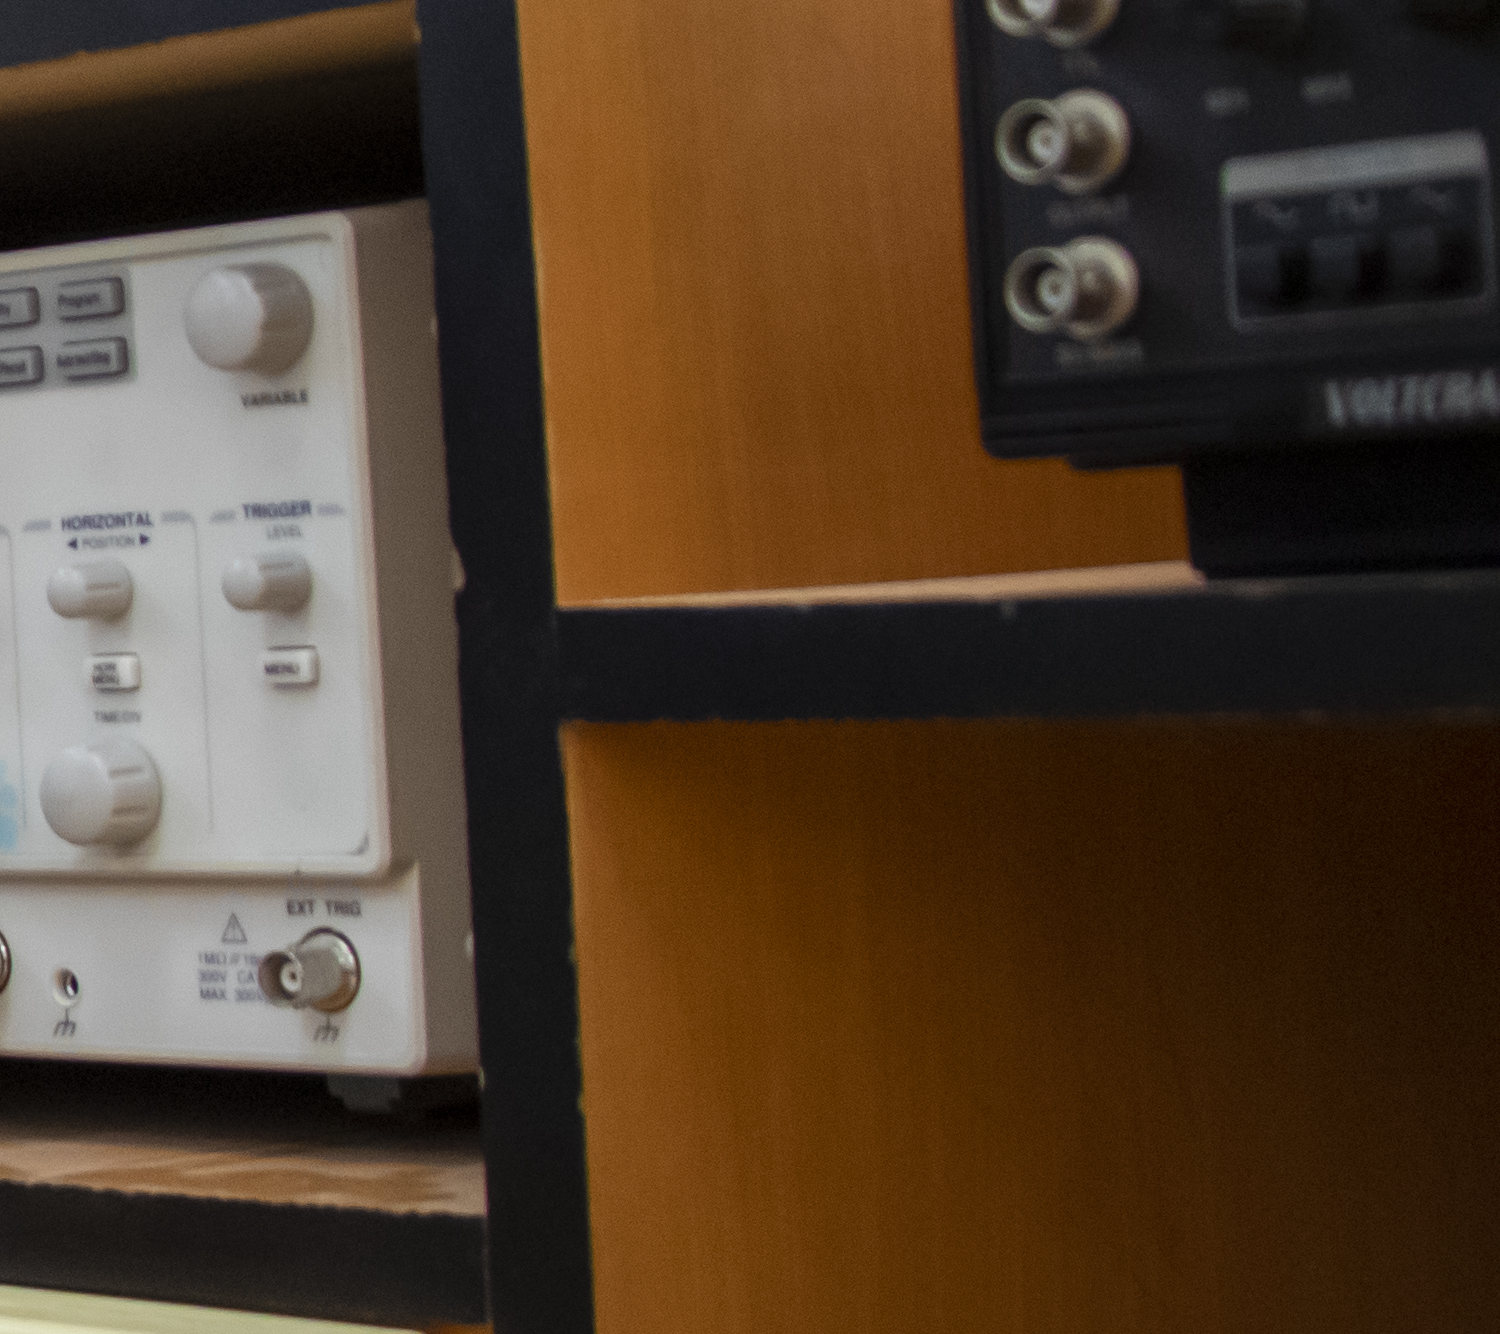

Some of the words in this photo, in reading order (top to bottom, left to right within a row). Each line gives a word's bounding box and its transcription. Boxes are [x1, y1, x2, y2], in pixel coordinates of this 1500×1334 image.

[239, 389, 309, 410] VARIABLE
[241, 498, 313, 520] TRIGGER
[60, 510, 155, 533] HORIZONTAL
[265, 523, 304, 541] LEVEL
[285, 898, 316, 917] EXT
[325, 898, 362, 917] TRIG
